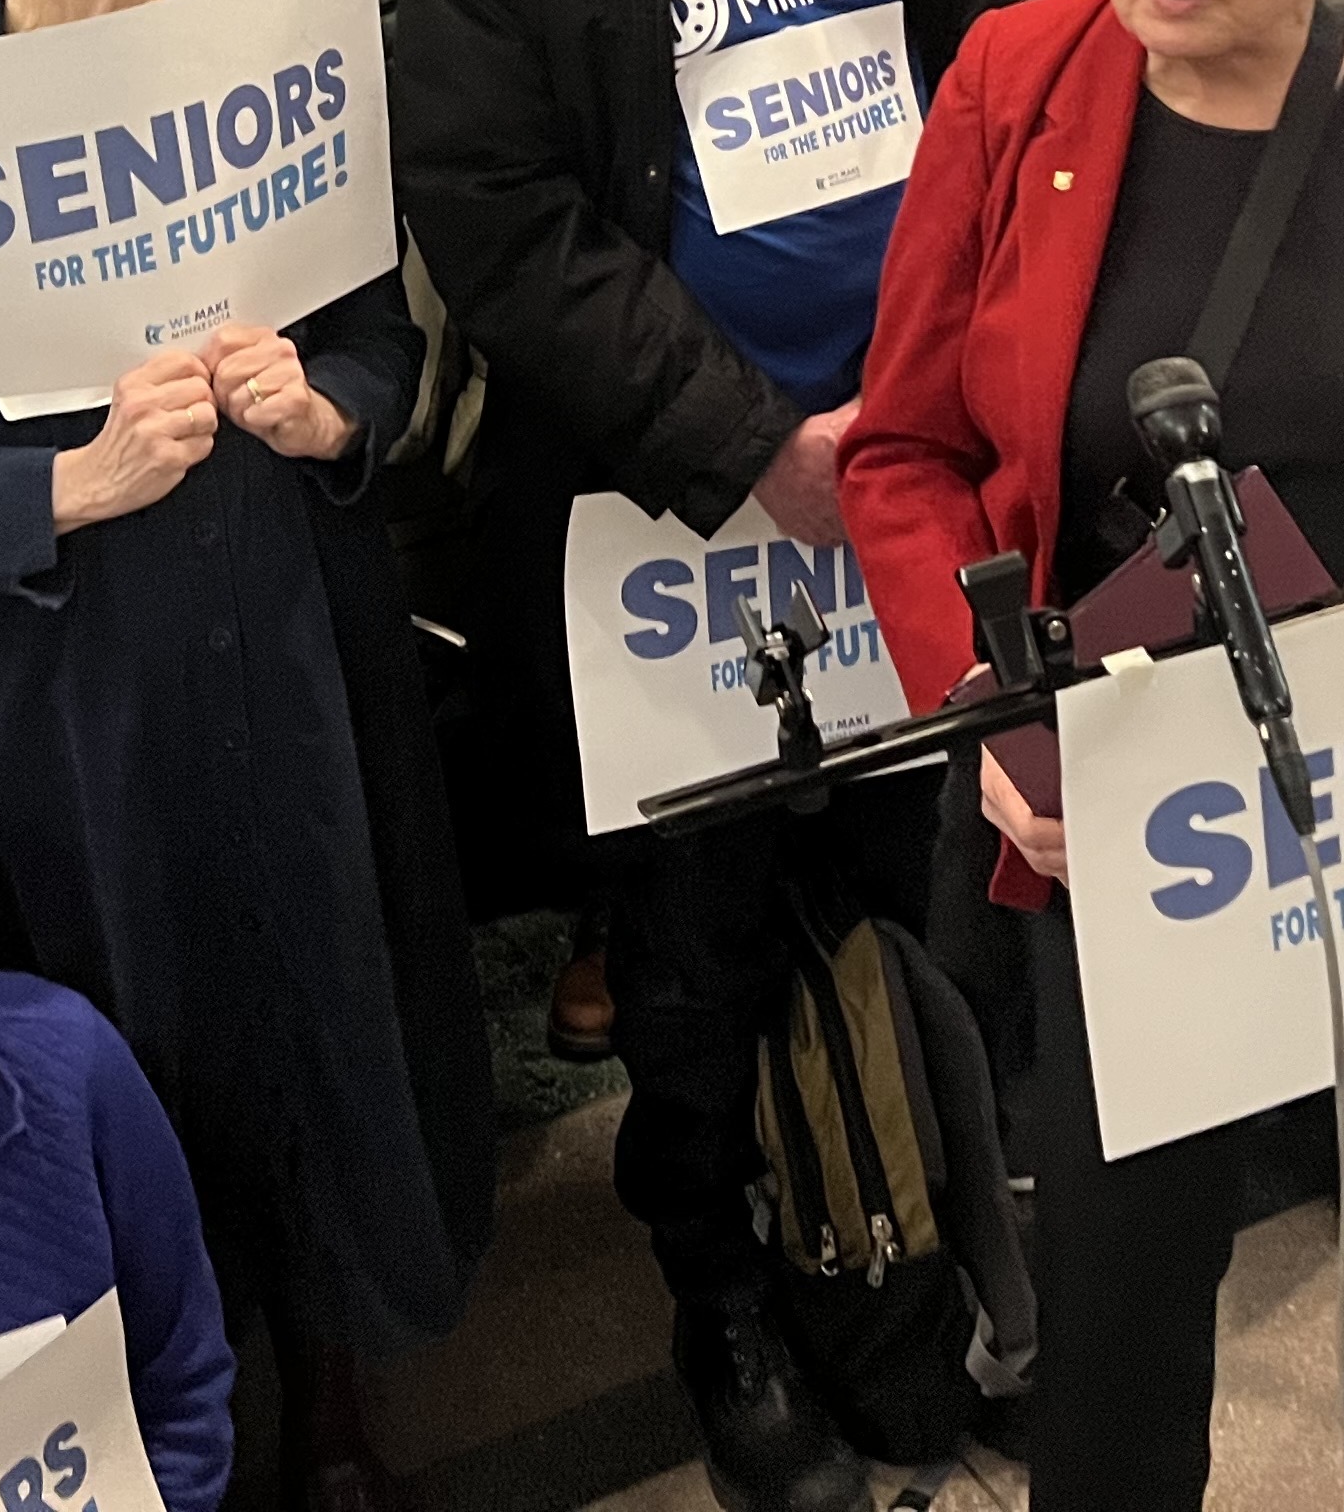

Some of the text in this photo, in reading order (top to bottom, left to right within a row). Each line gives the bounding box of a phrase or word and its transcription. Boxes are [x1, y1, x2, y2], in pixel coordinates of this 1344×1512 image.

[705, 50, 896, 152] SENIORS
[763, 92, 907, 164] FOR THE FUTURE!
[35, 129, 349, 291] FOR THE FUTURE!
[195, 298, 229, 322] MAKE
[621, 540, 865, 659] SENI
[1271, 898, 1325, 951] FOR
